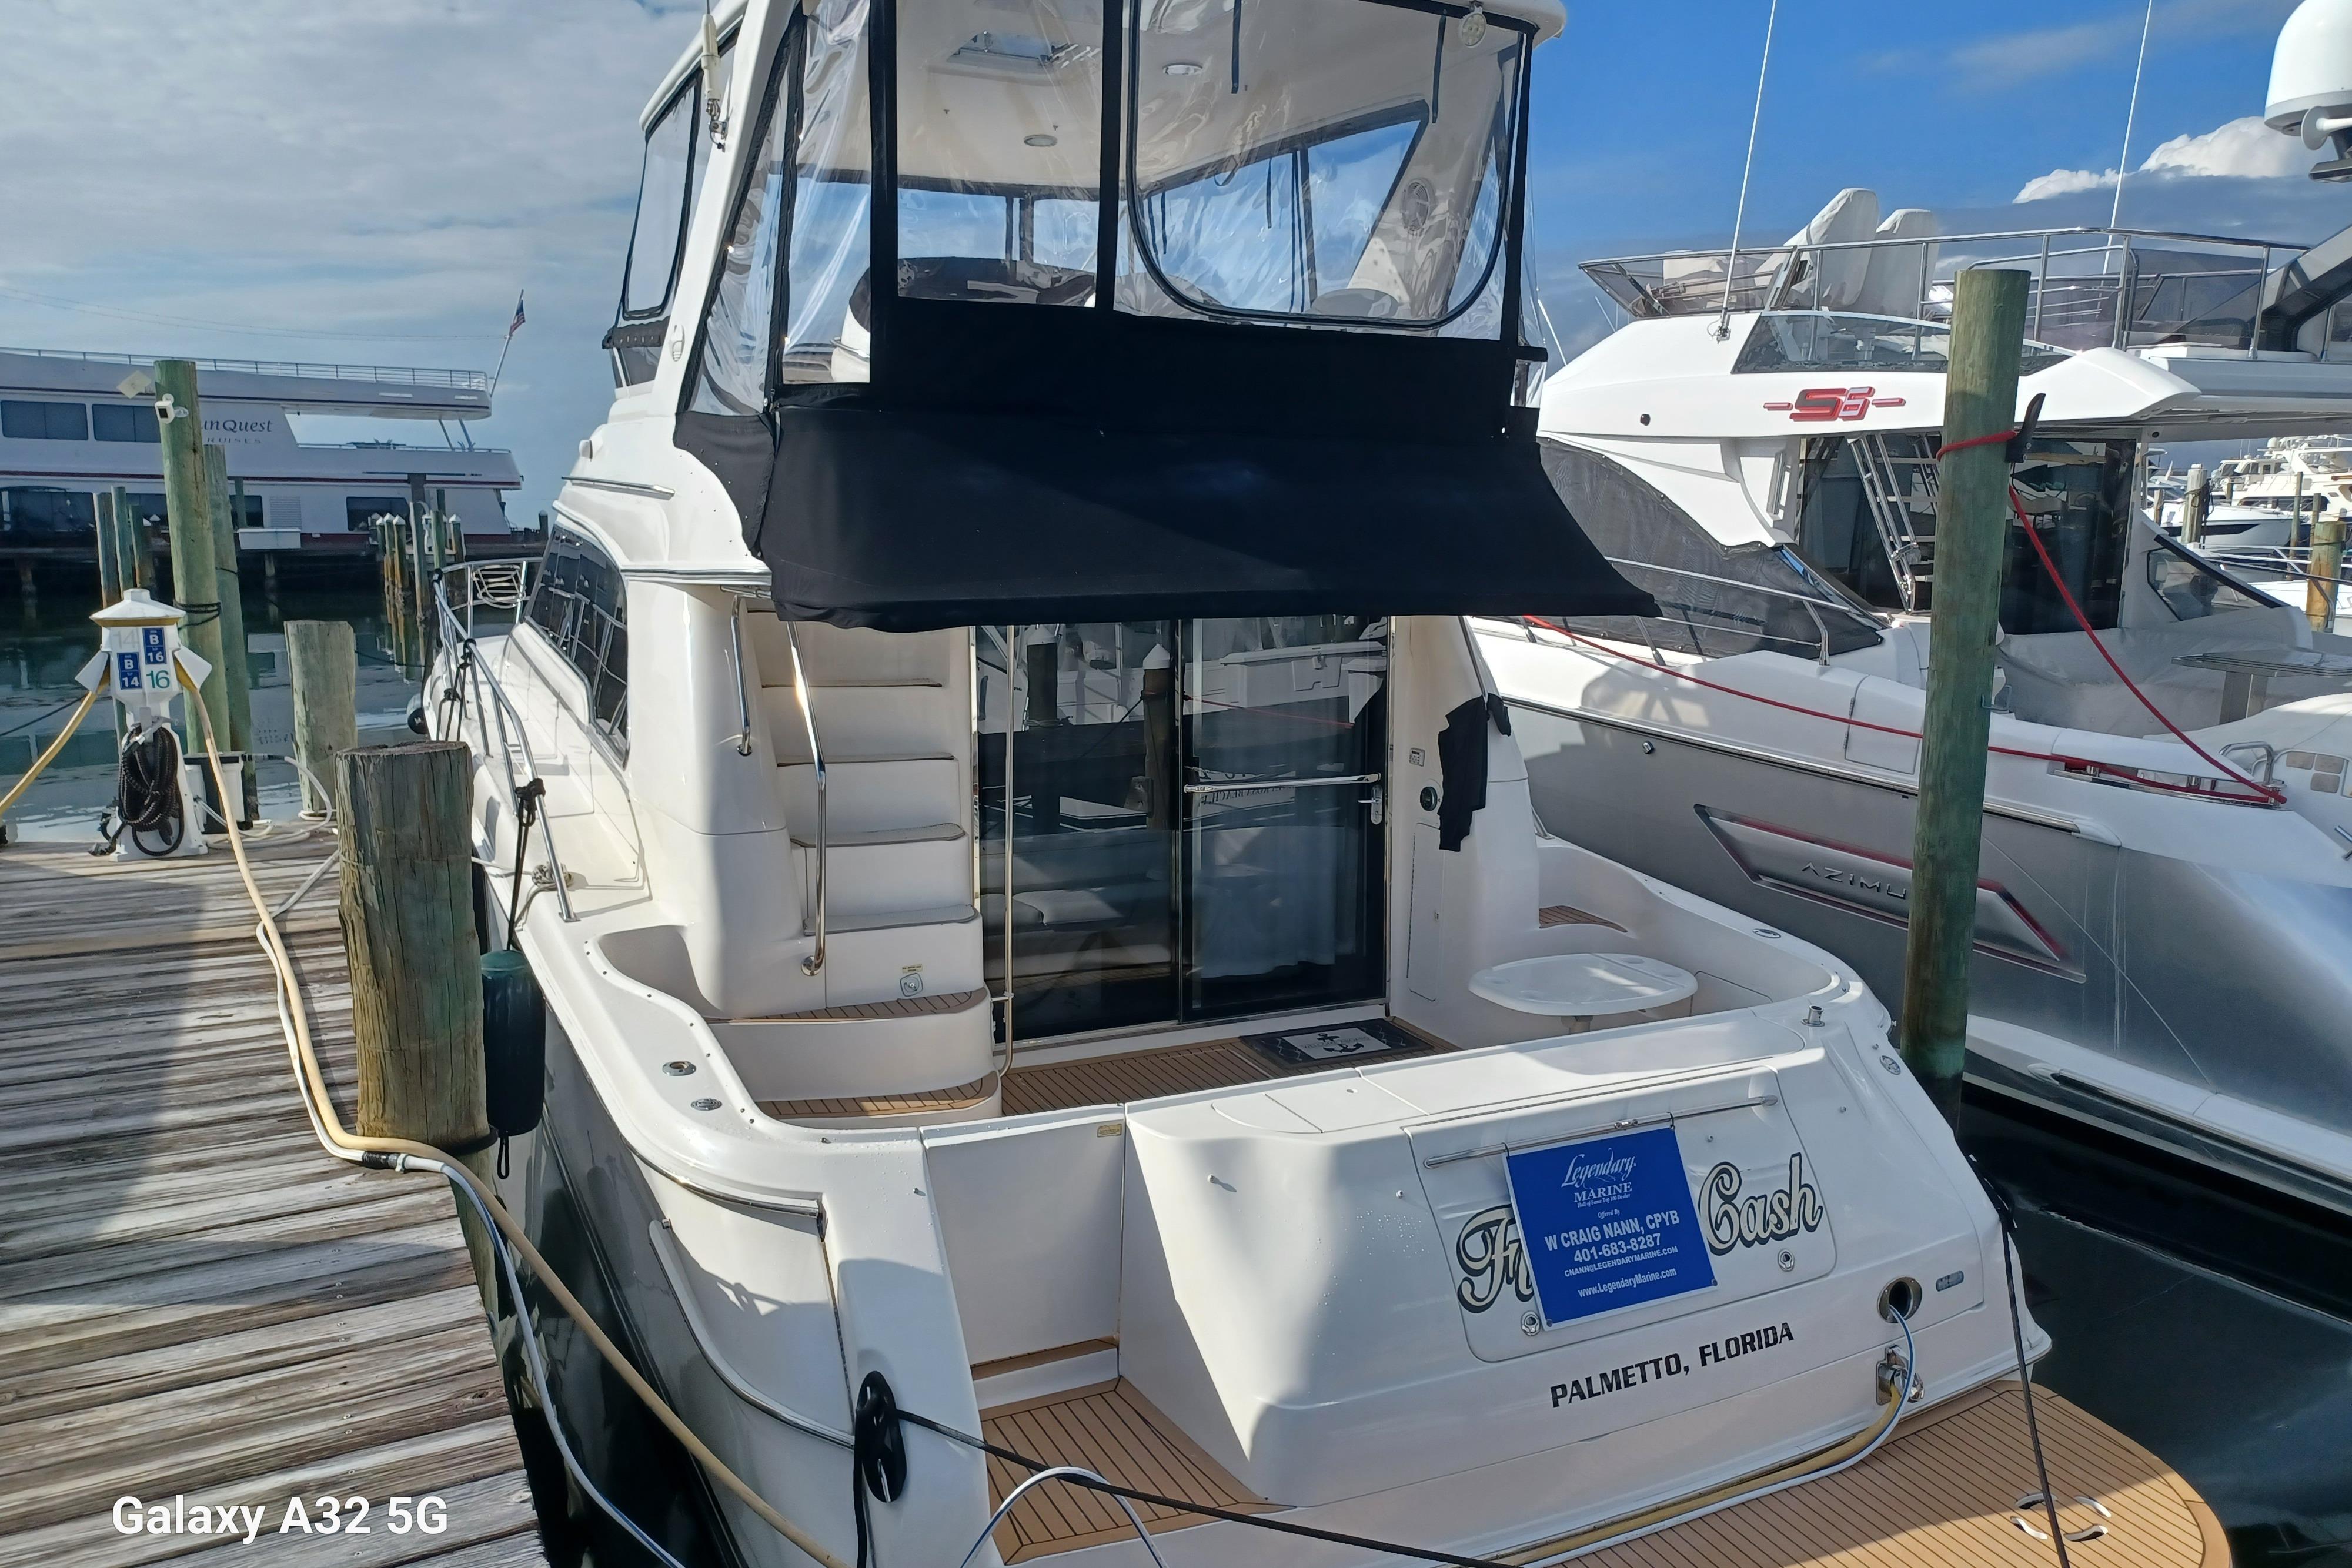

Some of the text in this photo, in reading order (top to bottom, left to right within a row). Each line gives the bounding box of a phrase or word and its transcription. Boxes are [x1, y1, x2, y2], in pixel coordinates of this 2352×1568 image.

[149, 634, 159, 645] B
[124, 659, 133, 670] B
[147, 651, 164, 663] 16
[122, 676, 139, 687] 14
[146, 670, 170, 688] 16
[1802, 862, 1906, 900] AZIMU
[1561, 1148, 1635, 1188] Legendary
[1573, 1182, 1632, 1203] MARINE
[1698, 1152, 1823, 1256] Cash
[1598, 1209, 1613, 1219] Offered
[1544, 1210, 1680, 1251] W CRAIG NANN, CPYB
[1564, 1246, 1678, 1278] CNANN@LEGENDARYMARINE.COM
[1574, 1233, 1661, 1263] 401-683-8287
[1578, 1268, 1678, 1298] www.LegendaryMarine.com
[1550, 1322, 1795, 1408] PALMETTO, FLORIDA
